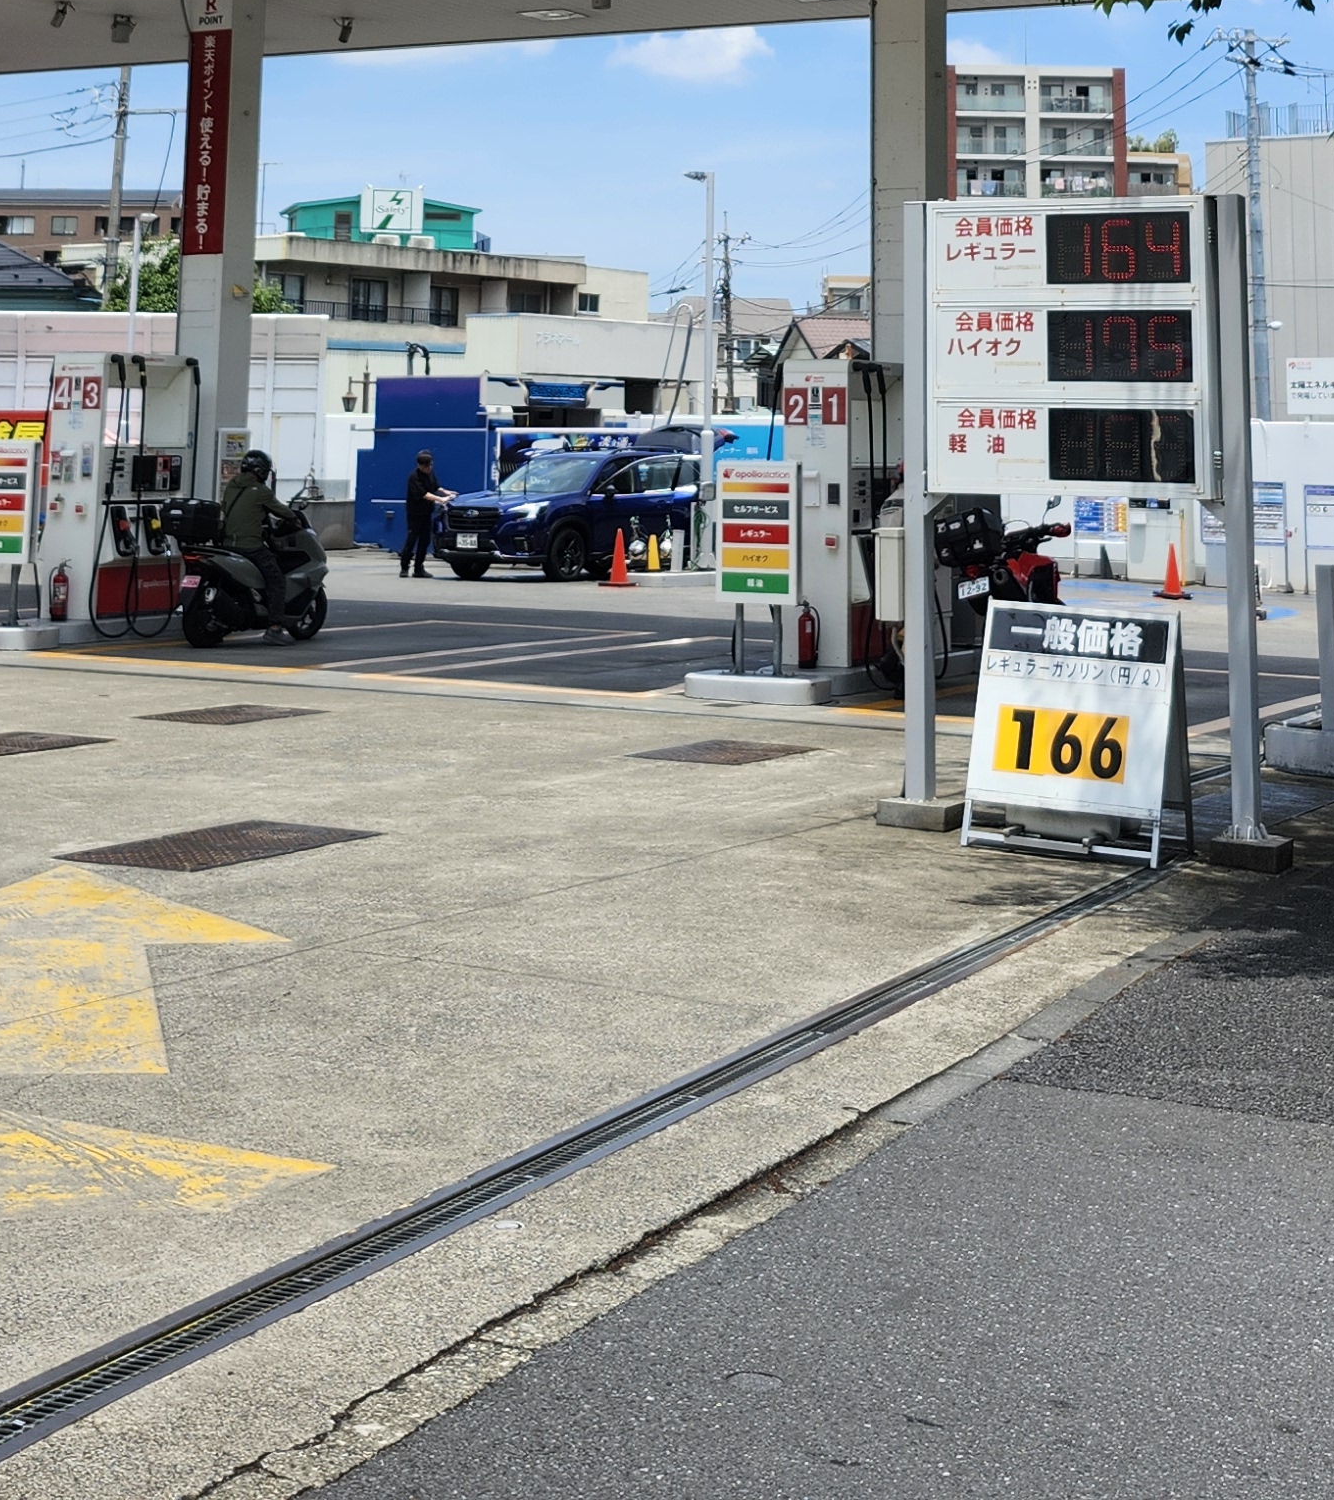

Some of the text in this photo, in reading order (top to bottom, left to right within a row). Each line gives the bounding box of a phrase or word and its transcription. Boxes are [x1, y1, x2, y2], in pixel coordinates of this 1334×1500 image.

[199, 15, 224, 26] POINT
[955, 217, 1034, 237] 会員価格
[947, 242, 1036, 262] レギュラー
[1084, 218, 1181, 280] 164
[955, 312, 1035, 333] 会員価格
[947, 337, 1022, 357] ハイオク
[1084, 315, 1184, 378] 175
[55, 378, 99, 409] 4 3
[788, 393, 838, 423] 2 1
[957, 408, 1037, 430] 会員価格
[734, 470, 791, 480] apollostation
[733, 504, 779, 514] セルフサービス
[739, 528, 772, 539] レギュラー
[742, 553, 769, 564] ハイオク
[1011, 616, 1144, 657] 一般価格
[1012, 708, 1123, 779] 166
